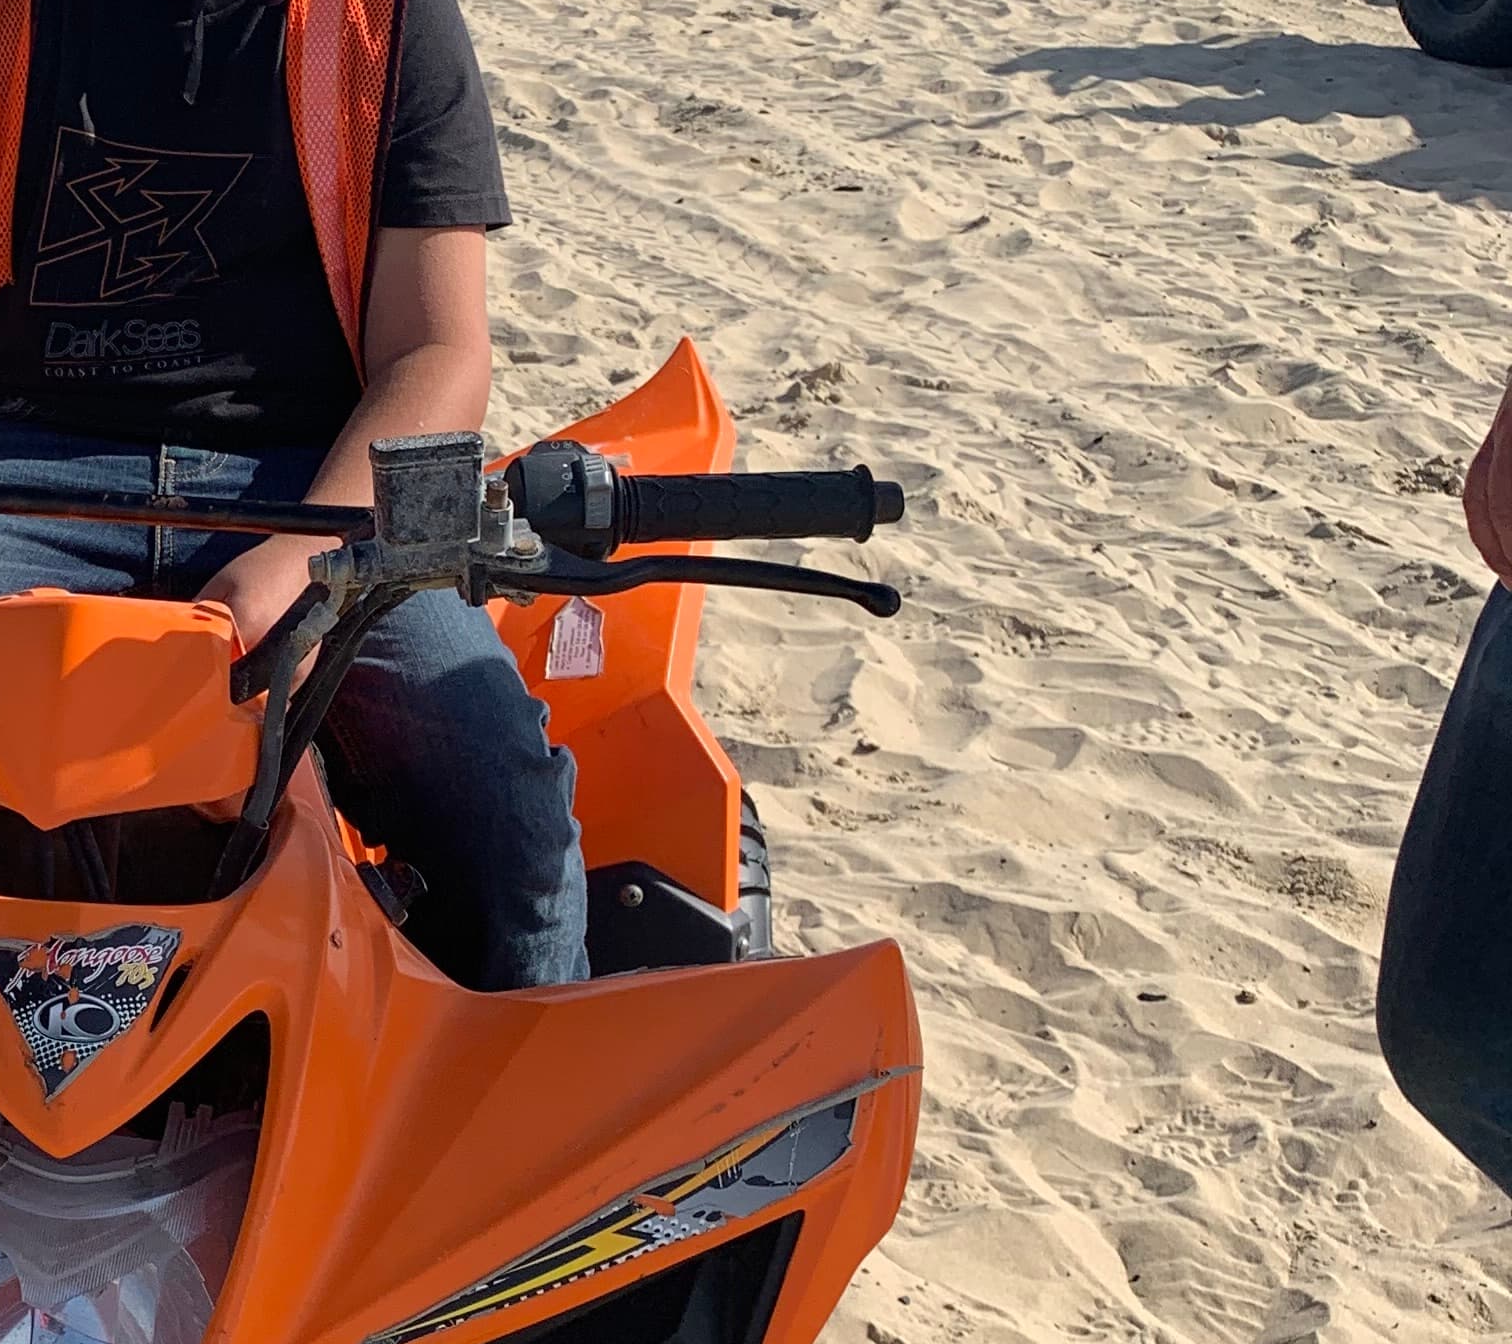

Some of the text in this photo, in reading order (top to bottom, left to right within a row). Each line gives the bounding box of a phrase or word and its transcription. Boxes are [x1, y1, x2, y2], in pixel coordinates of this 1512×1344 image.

[45, 355, 202, 377] COAST TO COAST
